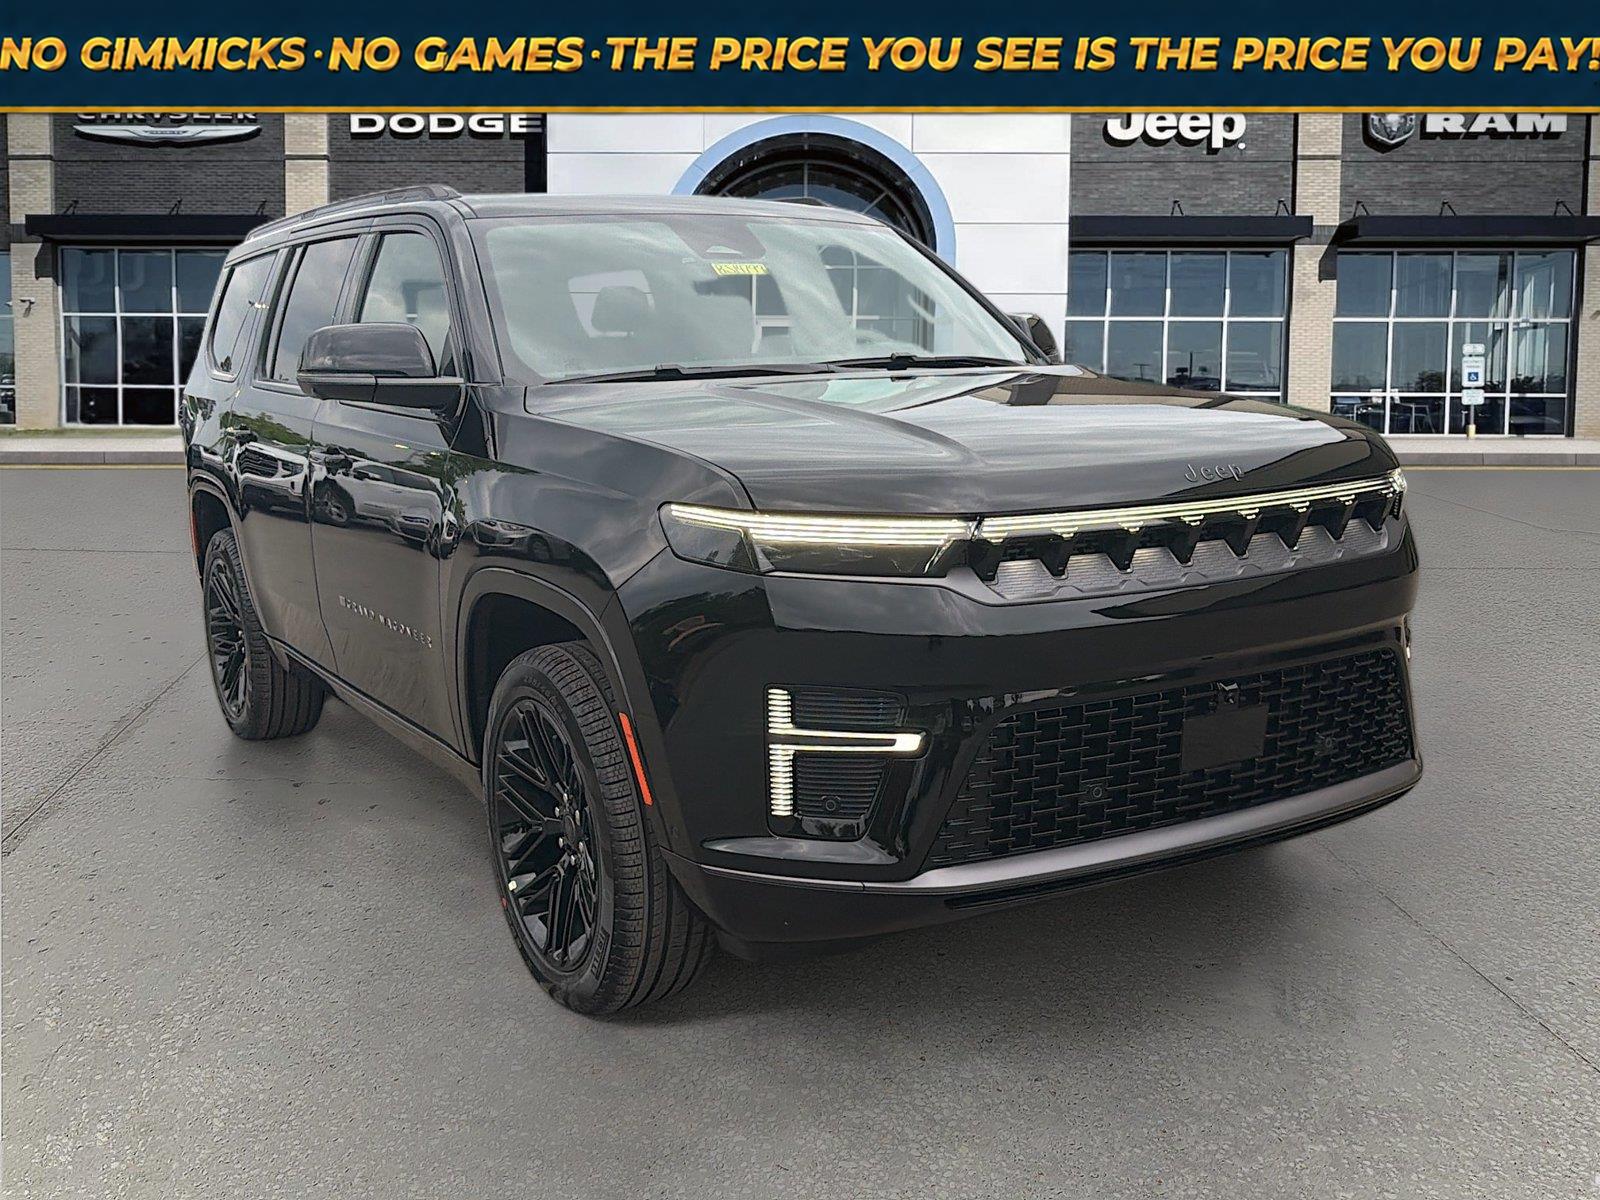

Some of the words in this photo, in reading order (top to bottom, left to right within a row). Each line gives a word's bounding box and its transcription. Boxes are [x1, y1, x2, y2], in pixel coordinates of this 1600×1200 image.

[350, 113, 543, 133] DODGE
[1107, 113, 1246, 149] Jeep
[1426, 113, 1567, 132] RAM
[1185, 463, 1243, 482] Jeep
